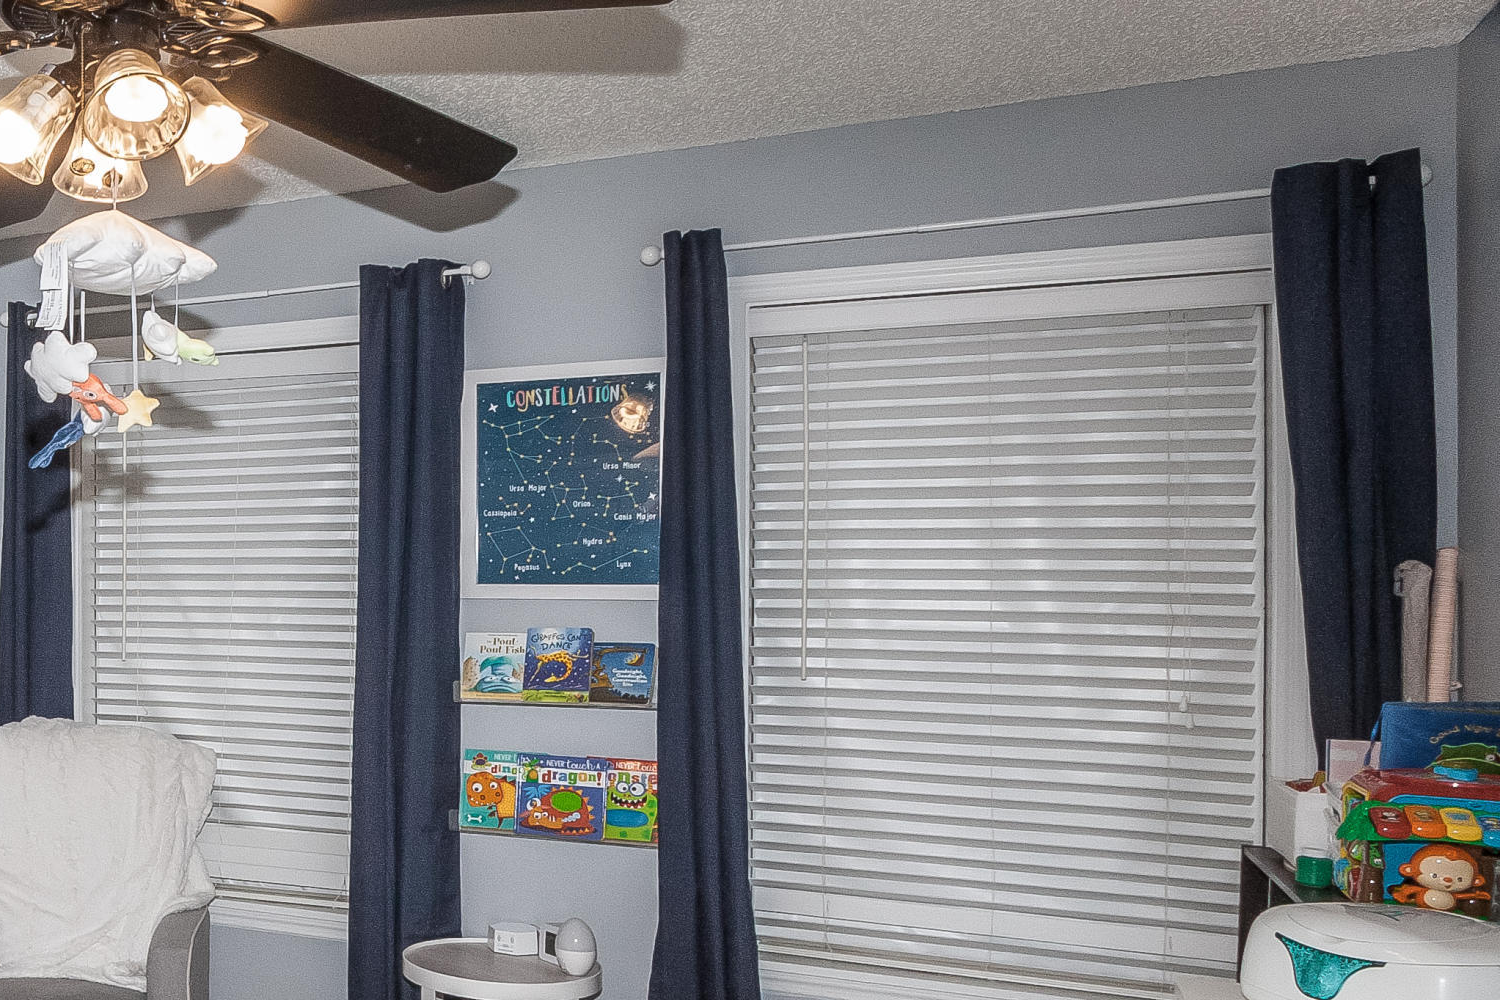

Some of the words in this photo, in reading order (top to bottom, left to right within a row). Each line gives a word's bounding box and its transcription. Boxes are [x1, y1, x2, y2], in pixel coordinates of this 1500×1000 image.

[506, 383, 628, 412] CONSTELLATIONS
[602, 462, 619, 470] Ursa
[622, 461, 641, 470] Minor
[509, 484, 525, 492] Ursa
[528, 484, 547, 493] Major
[636, 511, 657, 522] Major
[582, 537, 603, 547] Hydra
[514, 563, 540, 572] Pegasus
[616, 560, 632, 569] Lynx
[505, 645, 525, 654] Fish
[491, 764, 517, 775] dino
[542, 770, 602, 786] dragon!
